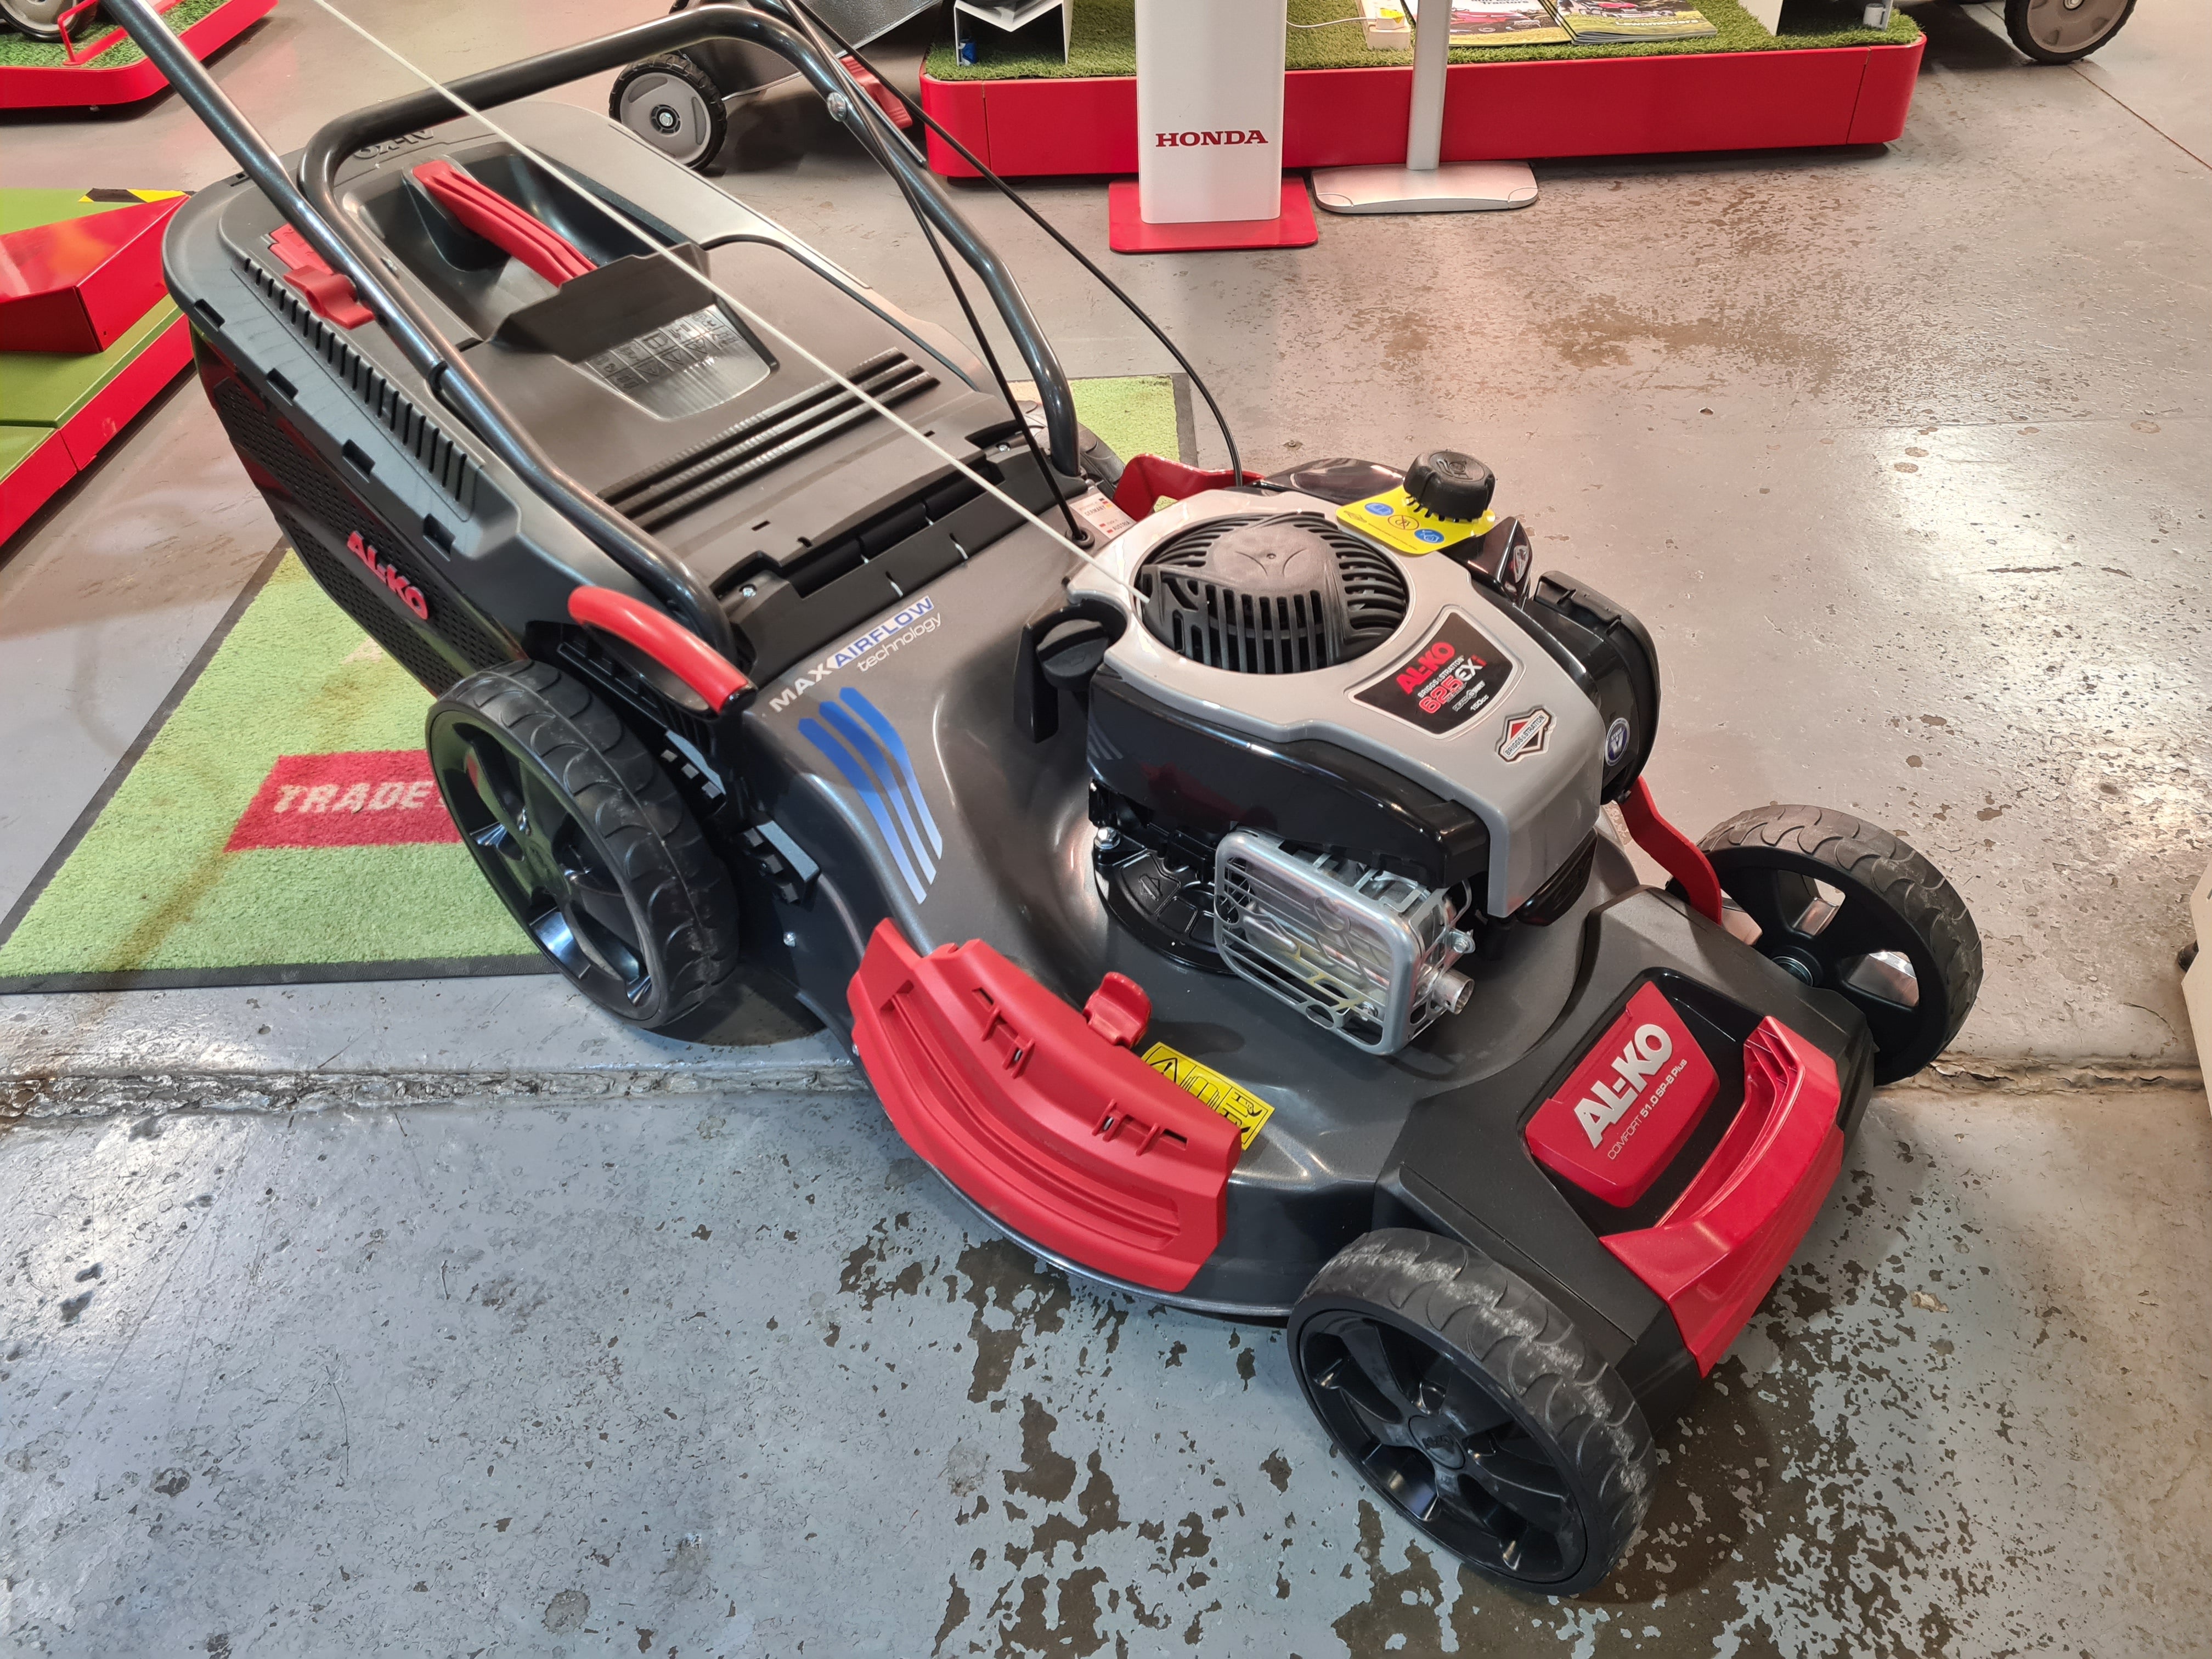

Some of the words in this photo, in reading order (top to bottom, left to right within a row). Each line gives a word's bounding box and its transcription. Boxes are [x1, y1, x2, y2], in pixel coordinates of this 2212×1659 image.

[1155, 129, 1268, 148] HONDA
[1085, 505, 1106, 516] GERMANY
[1112, 521, 1130, 531] AUSTRIA
[347, 531, 428, 620] AL-KO
[769, 663, 832, 713] MAX
[833, 597, 933, 668] AIRFLOW
[857, 613, 941, 672] technology
[1397, 642, 1455, 695] AL-KO
[273, 781, 434, 813] TRADE
[1574, 1024, 1673, 1149] AL-KO
[1607, 1116, 1642, 1160] COMFORT
[1640, 1093, 1659, 1118] 51.0
[1656, 1074, 1675, 1097] SP-B
[1671, 1059, 1688, 1078] Plus
